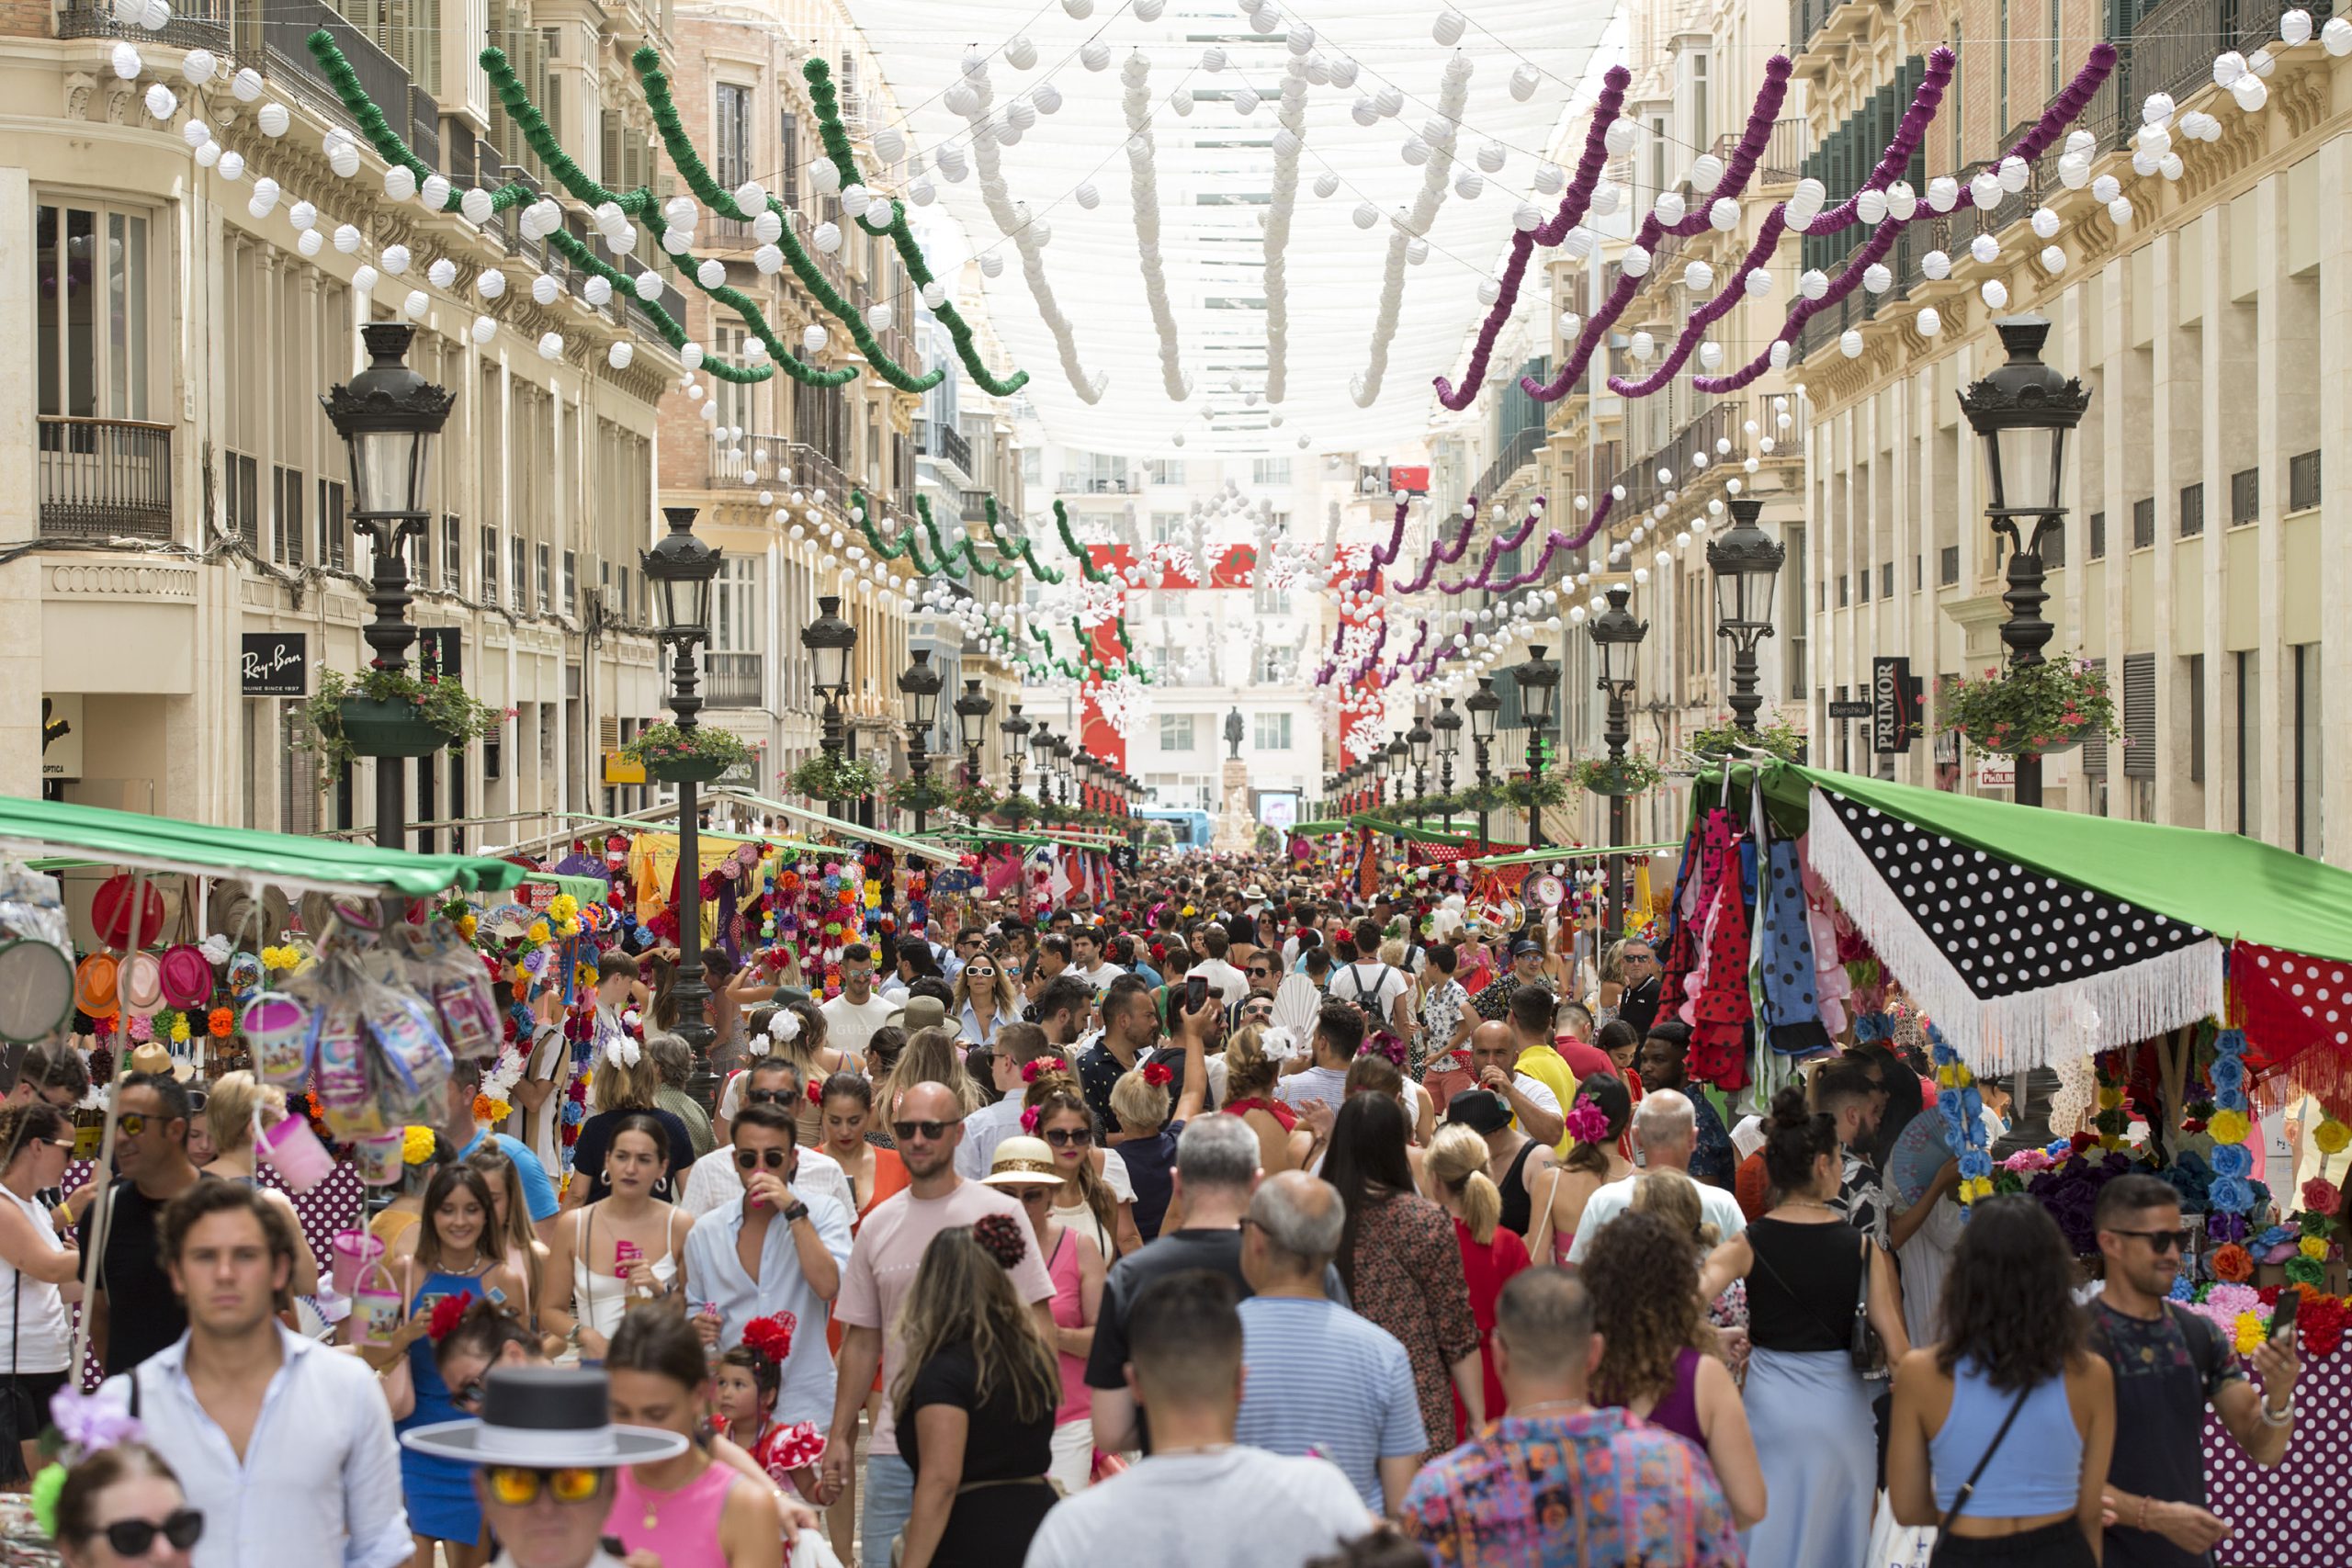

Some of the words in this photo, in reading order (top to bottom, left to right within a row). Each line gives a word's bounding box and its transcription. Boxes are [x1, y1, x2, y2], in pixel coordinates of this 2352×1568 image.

[243, 644, 301, 679] Ray-Ban
[1833, 705, 1866, 715] Bershka
[1877, 662, 1894, 750] PRIMOR
